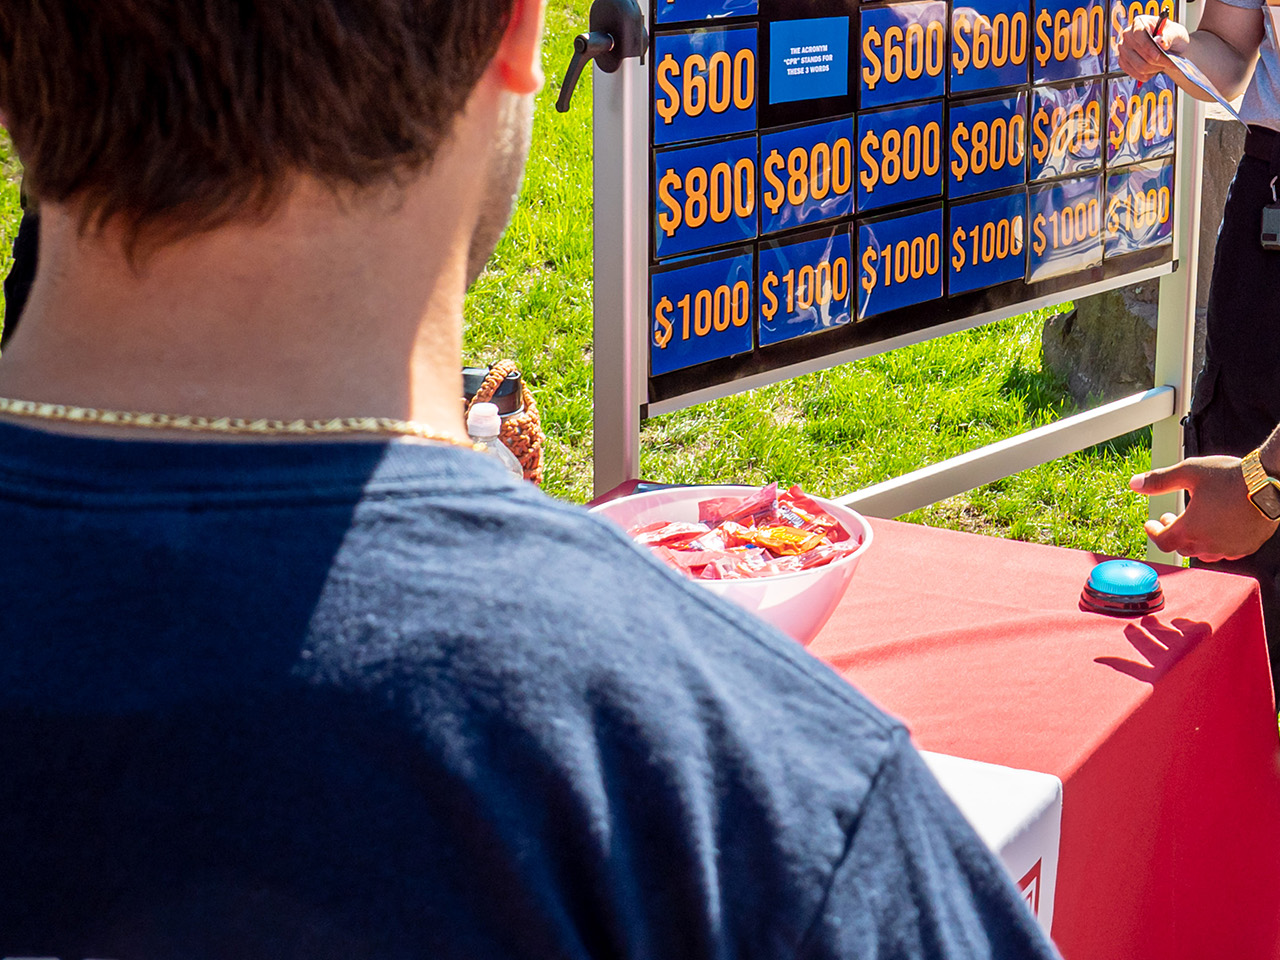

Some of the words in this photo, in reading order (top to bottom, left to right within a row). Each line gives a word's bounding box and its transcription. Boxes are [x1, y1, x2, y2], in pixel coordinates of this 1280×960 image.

[801, 45, 828, 53] ACRONYM
[801, 55, 821, 64] STANDS
[862, 20, 945, 89] $600
[952, 12, 1028, 75] $600
[1035, 5, 1104, 67] $600
[657, 48, 755, 124] $600
[810, 65, 829, 73] WORDS
[951, 115, 1024, 181] $800
[1110, 89, 1173, 150] $800
[764, 138, 851, 214] $800
[860, 121, 940, 192] $800
[658, 158, 755, 236] $800
[1033, 198, 1099, 257] $1000
[1108, 186, 1169, 237] $1000
[862, 233, 939, 293] $1000
[952, 215, 1023, 272] $1000
[655, 280, 749, 349] $1000
[762, 257, 848, 321] $1000
